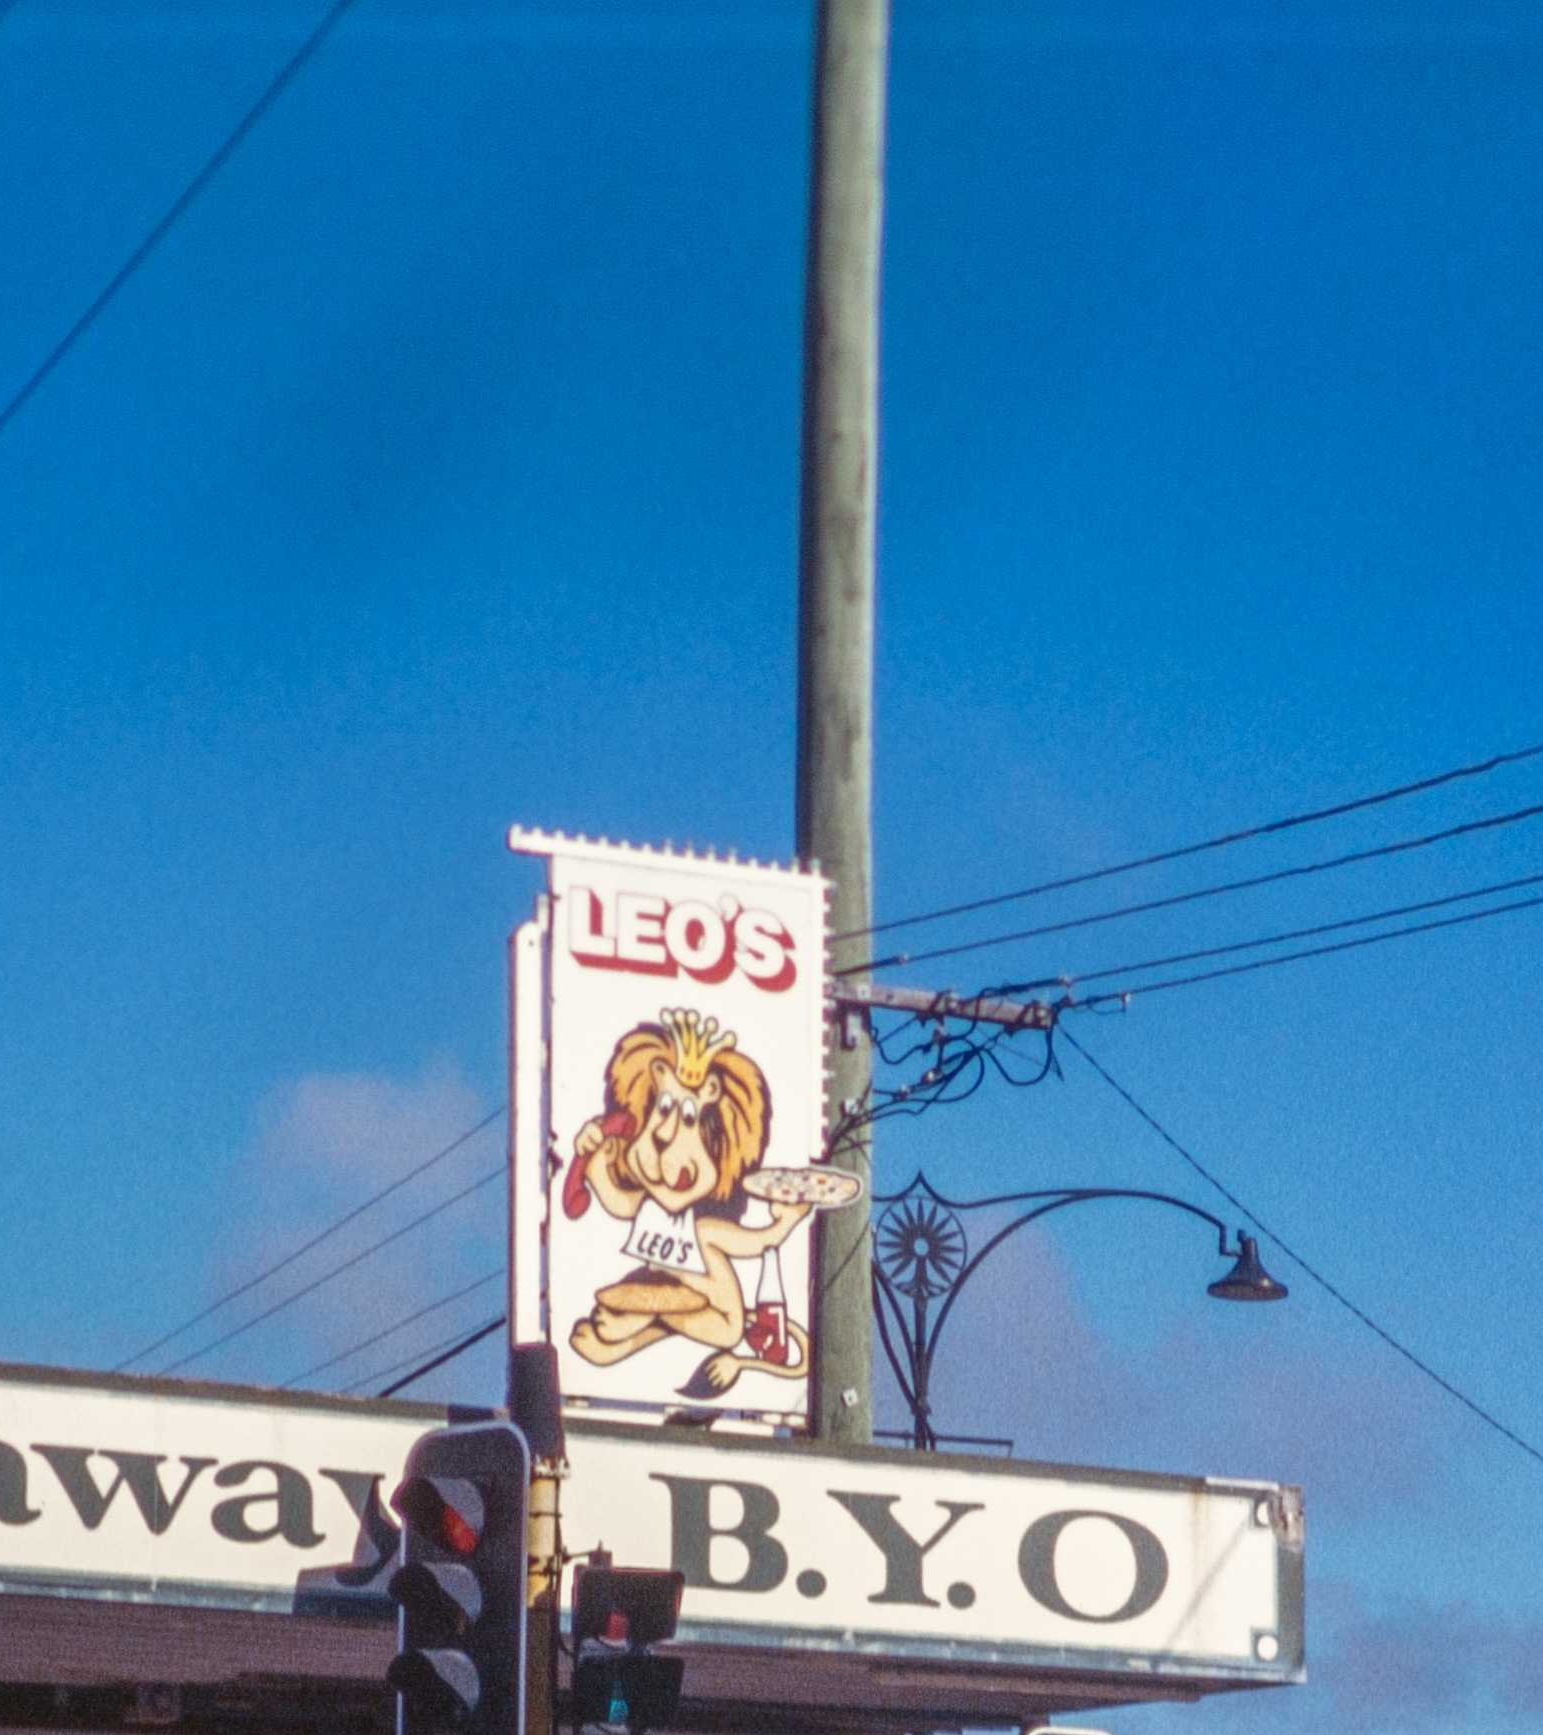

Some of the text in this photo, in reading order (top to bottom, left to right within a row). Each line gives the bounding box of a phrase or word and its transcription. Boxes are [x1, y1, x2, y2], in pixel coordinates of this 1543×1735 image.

[567, 884, 797, 991] LEO'S
[637, 1230, 694, 1264] LEO'S
[650, 1472, 1170, 1624] B.Y.O
